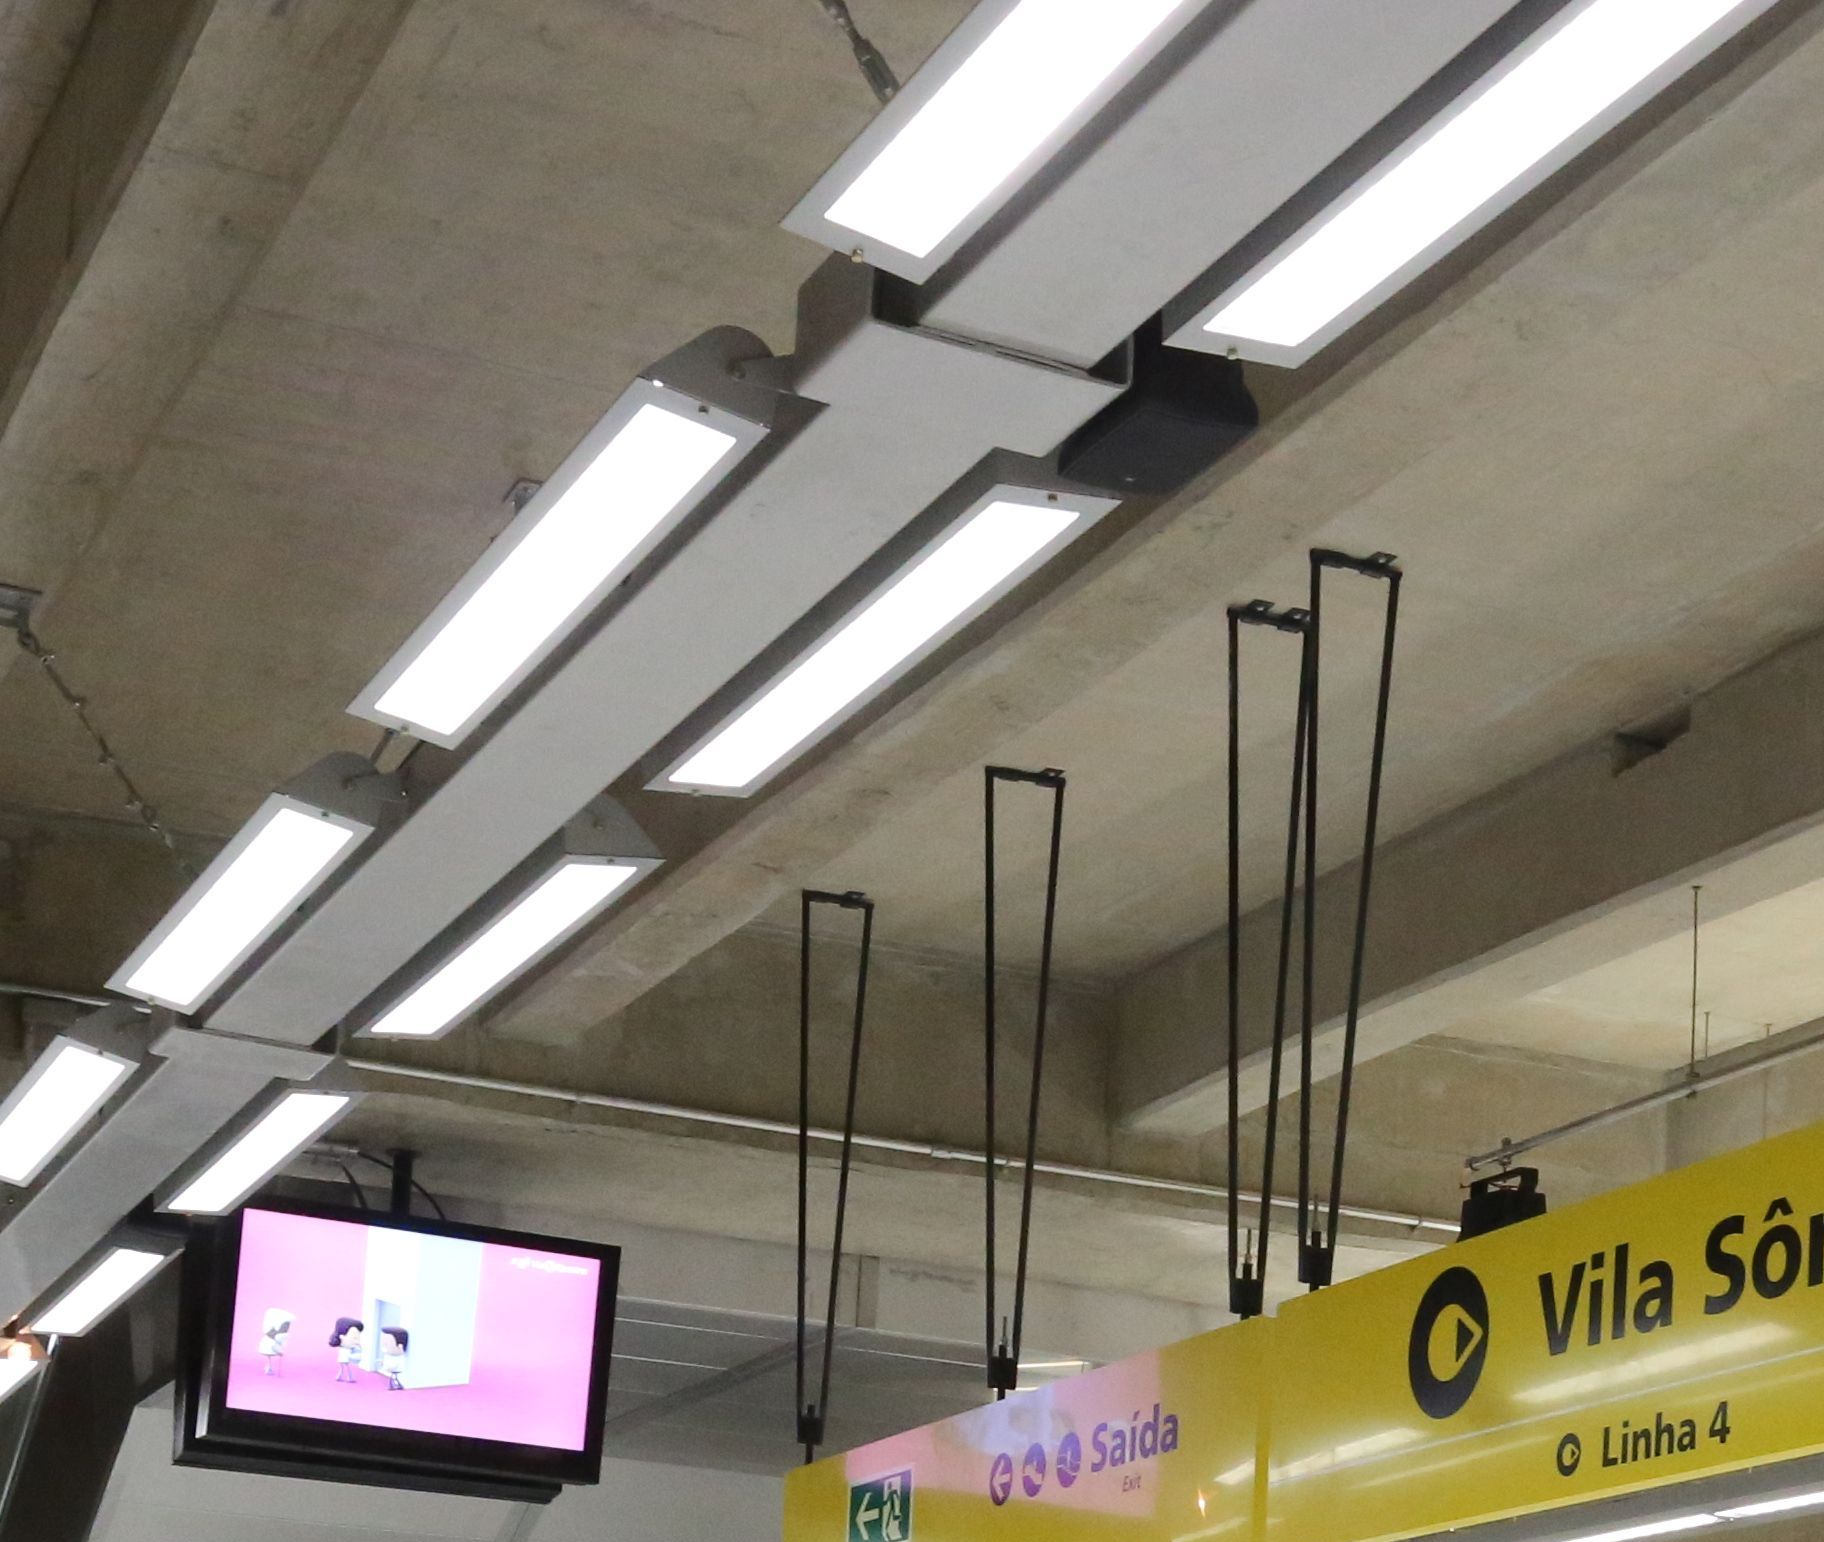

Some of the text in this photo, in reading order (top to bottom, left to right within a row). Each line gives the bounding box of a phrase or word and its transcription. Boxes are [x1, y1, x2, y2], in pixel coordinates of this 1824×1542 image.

[1538, 1241, 1674, 1357] Vila
[1091, 1403, 1179, 1473] Saída
[1602, 1401, 1731, 1468] Linha 4
[1122, 1475, 1141, 1493] Exit
